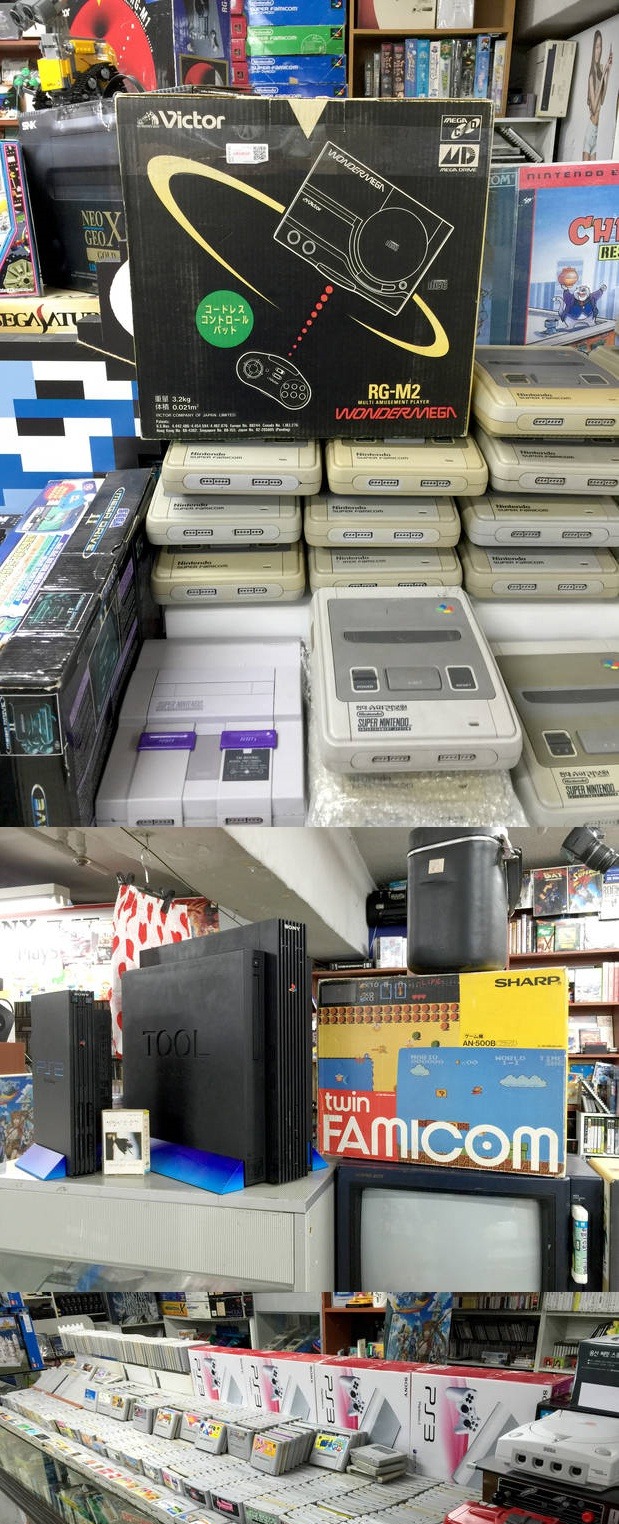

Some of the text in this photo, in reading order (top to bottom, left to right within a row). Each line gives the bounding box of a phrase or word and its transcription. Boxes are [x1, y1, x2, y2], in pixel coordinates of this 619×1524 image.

[22, 121, 37, 131] SNK
[159, 111, 226, 129] Victor
[526, 170, 604, 180] NINTENDO
[81, 210, 104, 226] NEO
[103, 211, 122, 247] X
[568, 216, 619, 245] CH
[85, 230, 106, 246] GEO
[600, 246, 619, 259] RE
[0, 312, 40, 326] EGA
[201, 315, 249, 325] コントロール
[368, 384, 421, 400] RG-M2
[335, 406, 458, 420] WONDERMEGA
[357, 717, 410, 728] SUPER NINTENDO
[565, 783, 616, 795] SUPER NINTENDO
[494, 975, 561, 988] SHARP
[142, 1028, 211, 1058] TOOL
[325, 1091, 370, 1113] twin
[322, 1114, 559, 1173] FAMICOM
[324, 1374, 335, 1424] PS3
[423, 1386, 437, 1443] PS3
